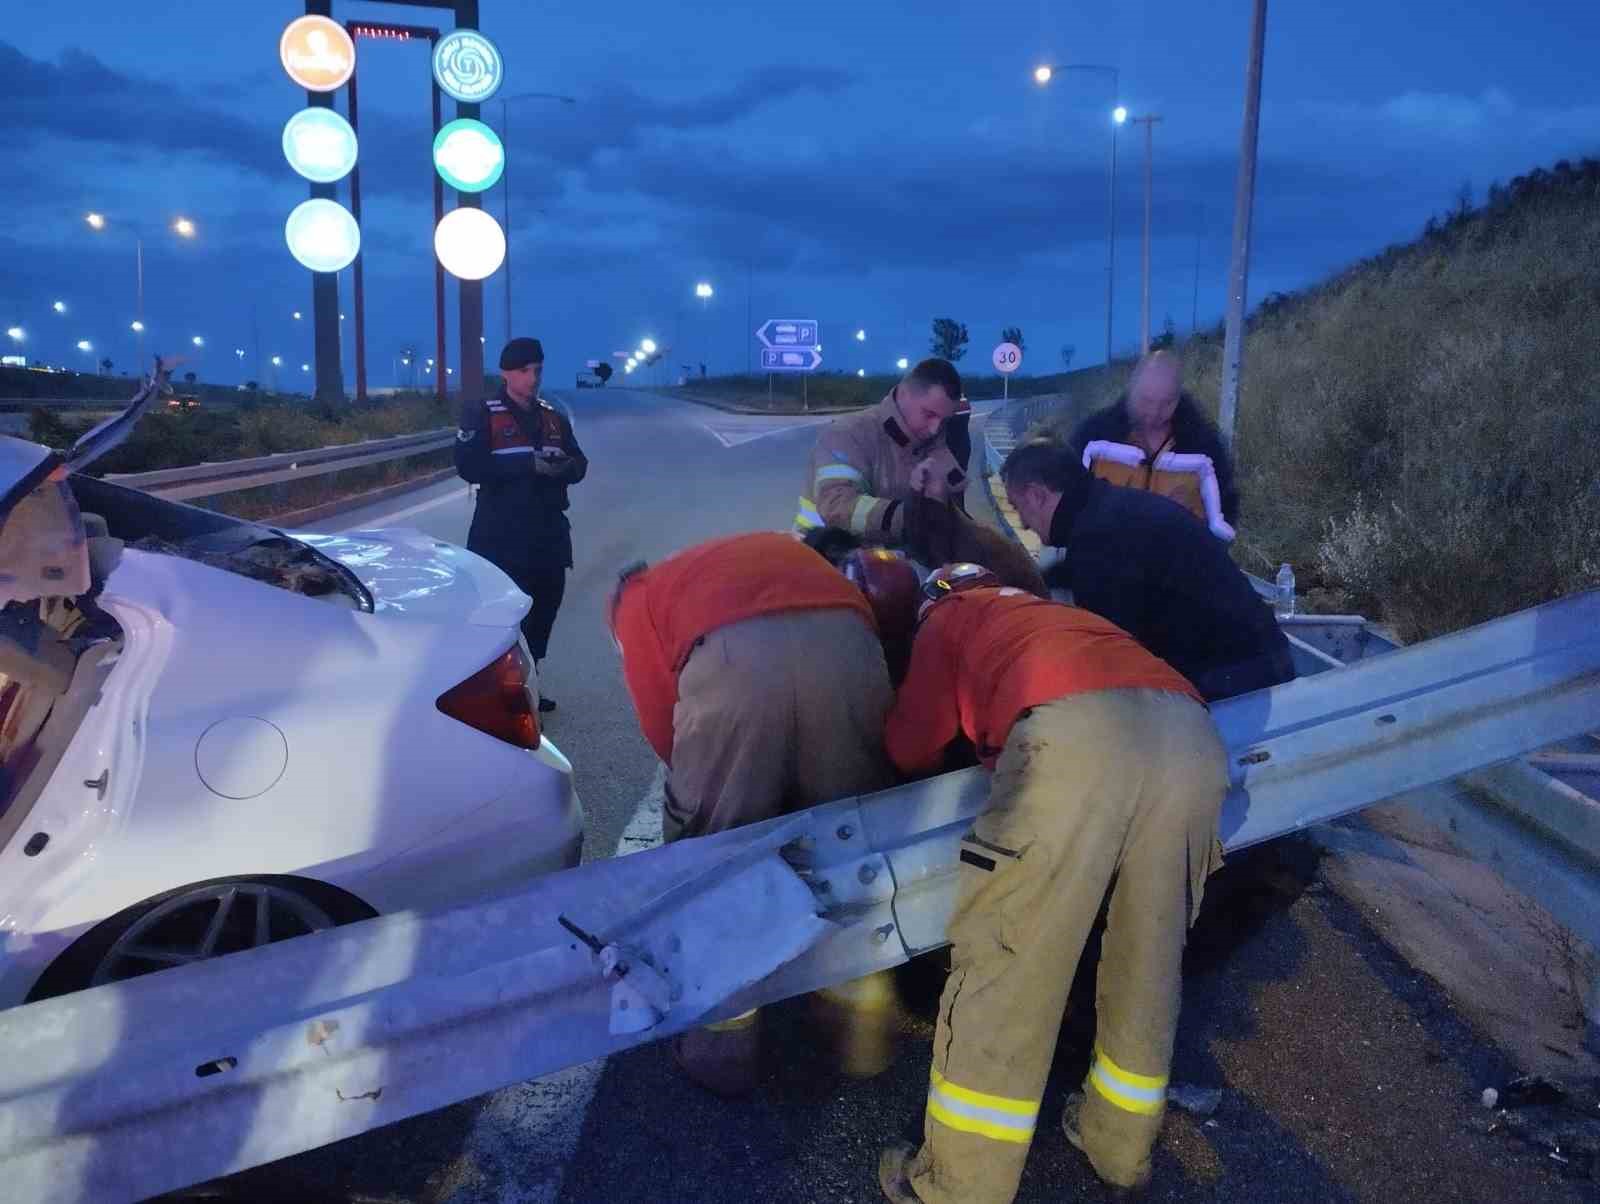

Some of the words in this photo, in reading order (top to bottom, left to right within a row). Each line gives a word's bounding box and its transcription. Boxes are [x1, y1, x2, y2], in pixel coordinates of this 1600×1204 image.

[801, 328, 809, 341] P
[769, 353, 777, 365] P
[999, 351, 1016, 364] 30
